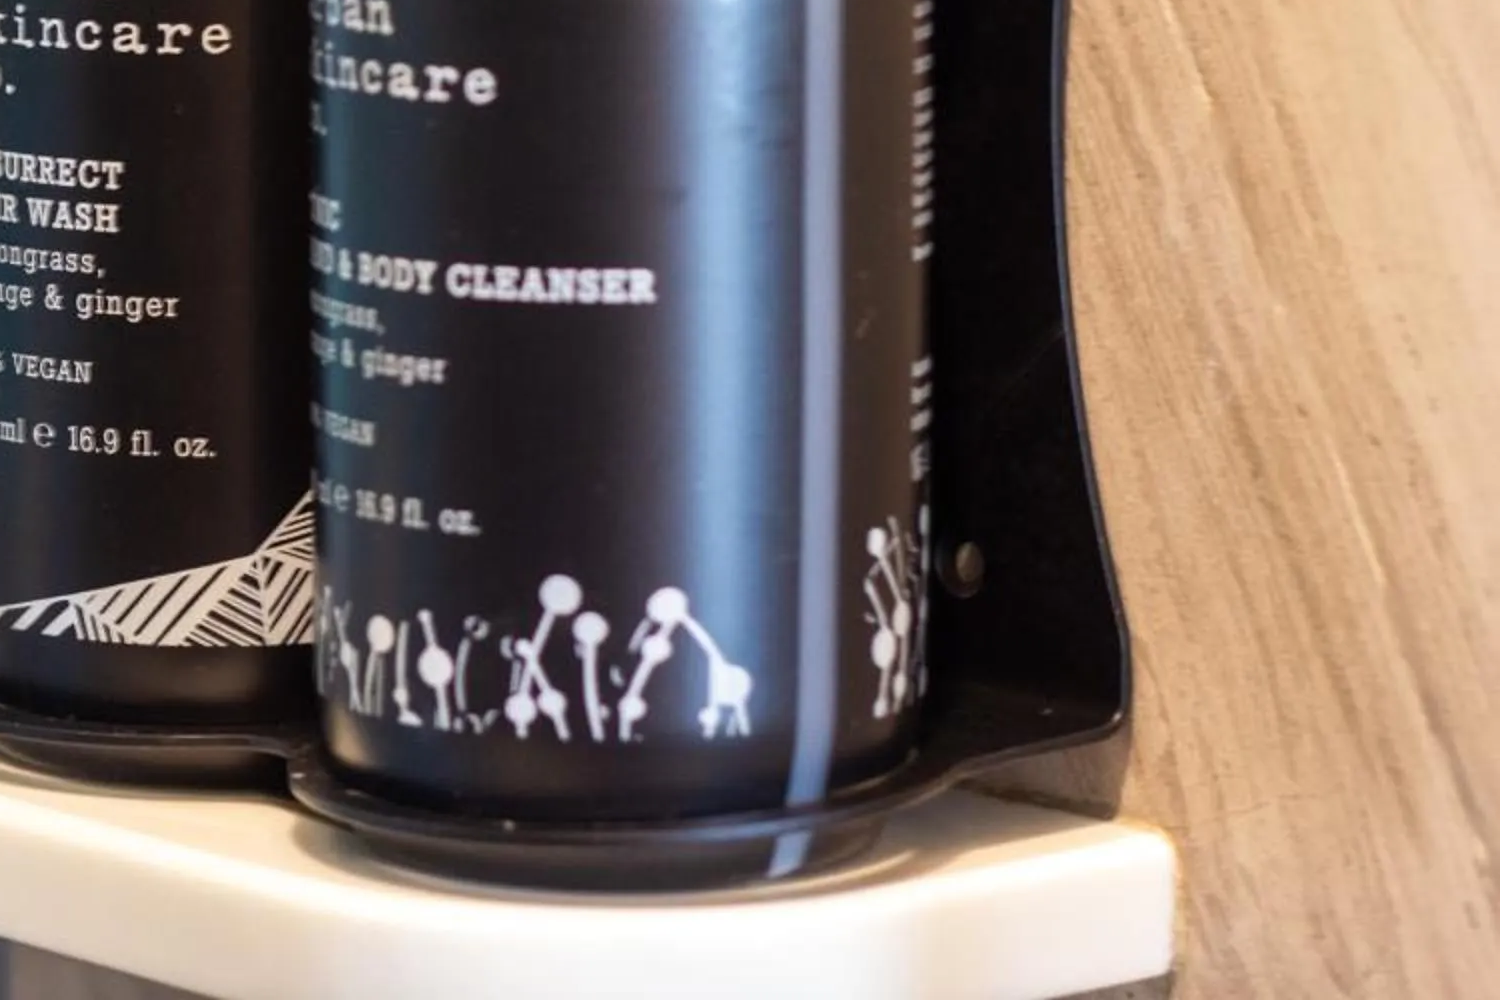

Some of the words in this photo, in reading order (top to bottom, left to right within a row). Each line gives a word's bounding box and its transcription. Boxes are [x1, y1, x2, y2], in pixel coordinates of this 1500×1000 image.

[26, 197, 120, 233] WASH
[358, 251, 438, 295] BODY
[445, 262, 657, 304] CLEANSER
[43, 283, 64, 310] &
[76, 289, 180, 323] ginger
[12, 353, 94, 384] VEGAN
[361, 346, 448, 387] ginger
[0, 417, 26, 444] ml
[68, 425, 121, 454] 16.9
[129, 429, 160, 457] fl.
[173, 437, 216, 458] oz.
[438, 508, 481, 536] oz.
